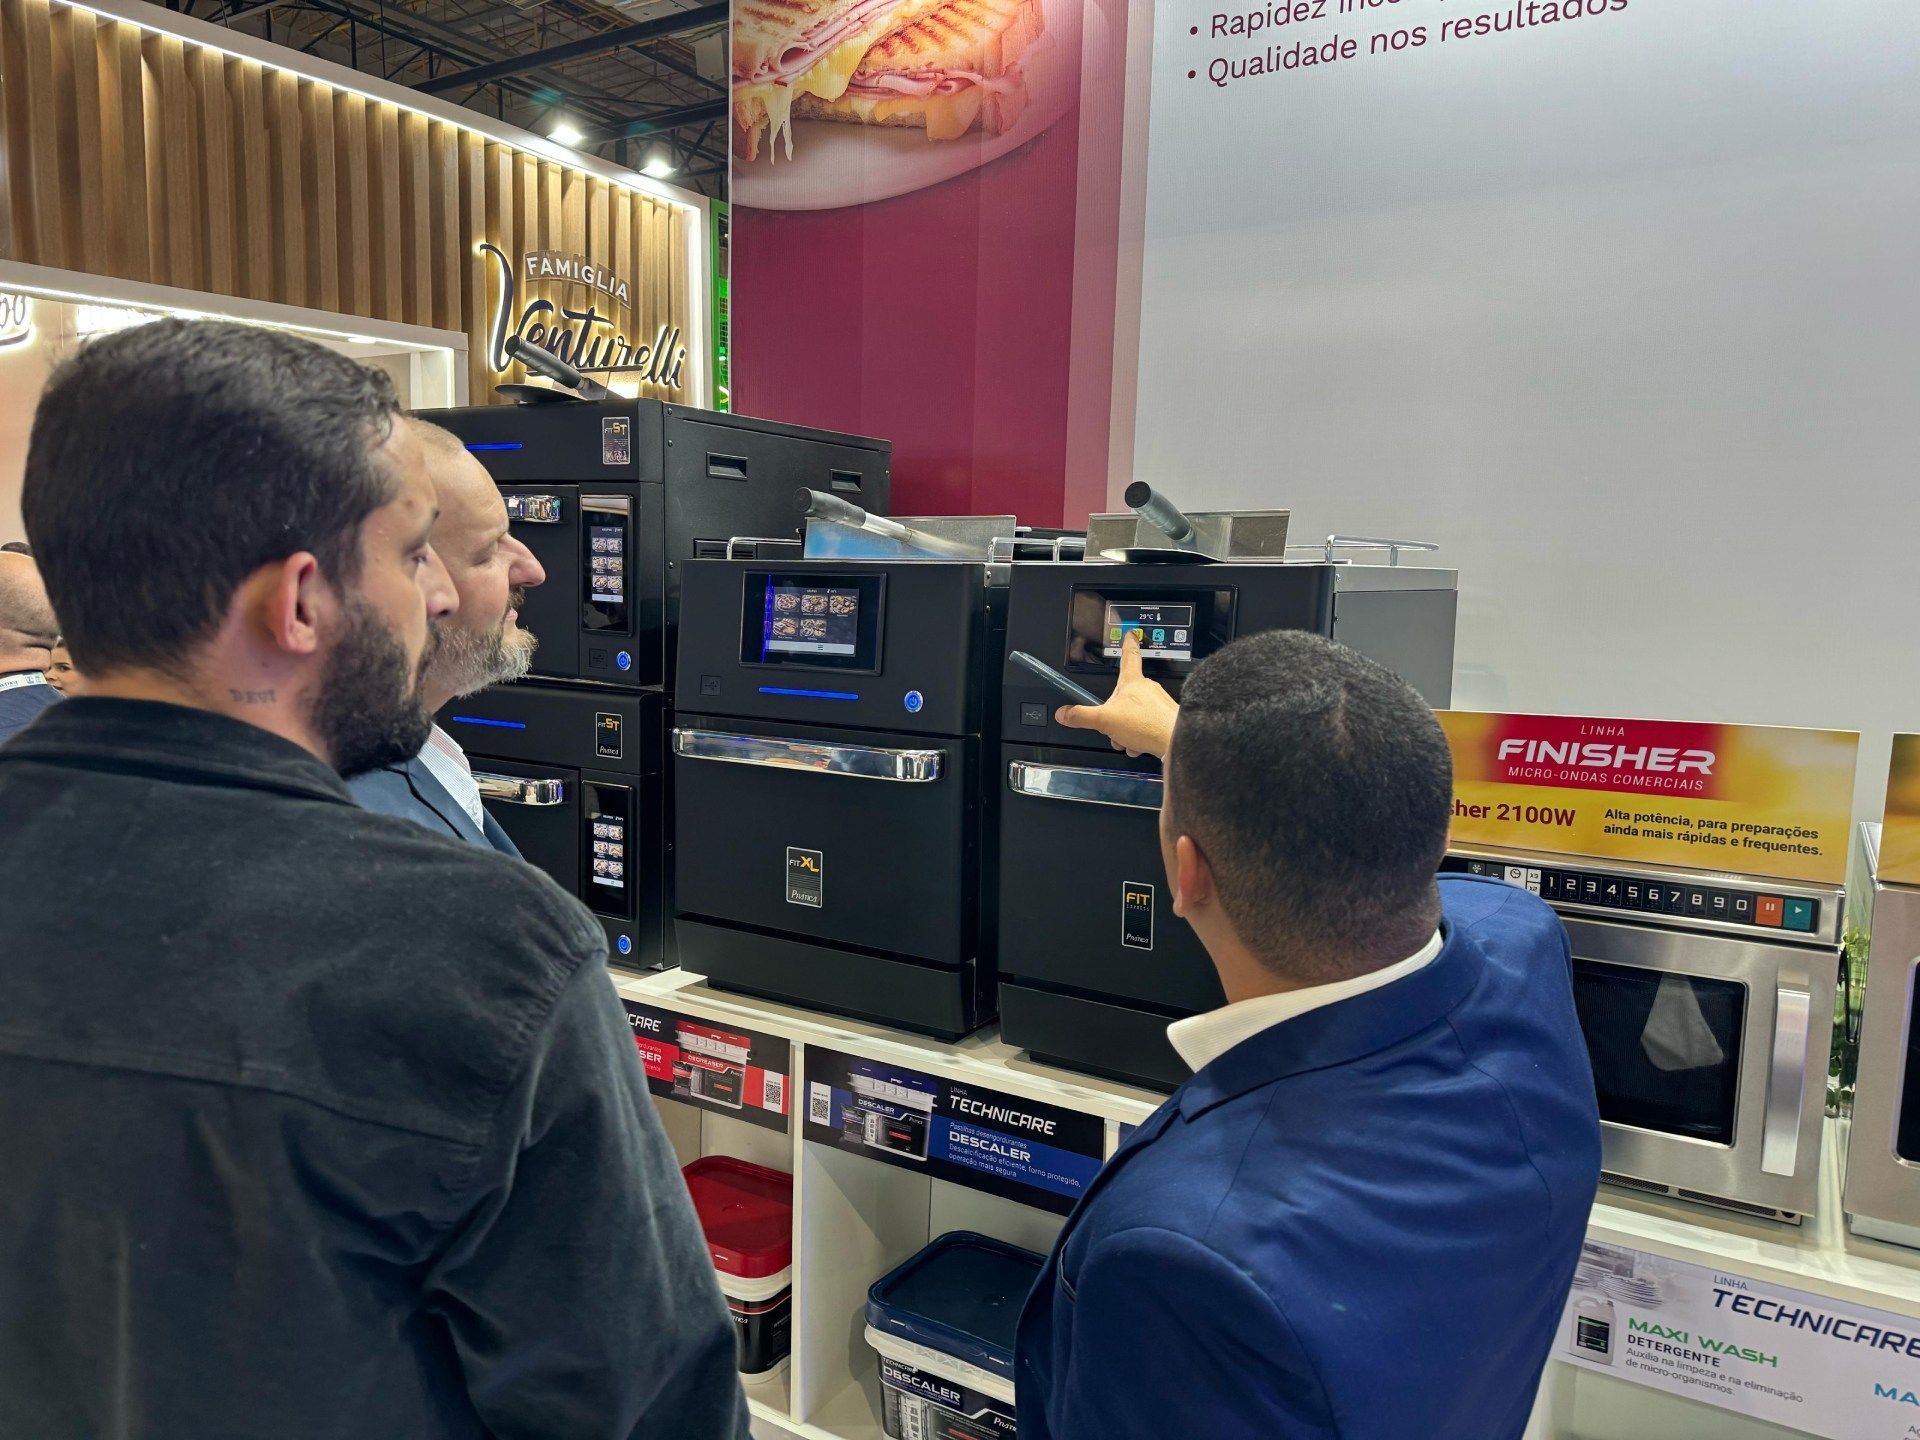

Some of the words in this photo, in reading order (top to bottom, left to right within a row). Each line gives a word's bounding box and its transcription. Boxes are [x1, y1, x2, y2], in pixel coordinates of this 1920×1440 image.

[1211, 0, 1327, 39] Rapidez
[1208, 34, 1358, 87] Qualidade
[1370, 26, 1427, 55] nos
[526, 256, 629, 302] FAMIGLIA
[479, 242, 688, 389] Venturelli
[1580, 724, 1626, 737] LINHA
[1497, 738, 1716, 774] FINISHER
[1508, 766, 1607, 784] MICRO-ONDAS
[1612, 773, 1704, 791] COMERCIAIS
[1496, 803, 1576, 827] 2100W
[1604, 808, 1630, 821] Alta
[1633, 812, 1694, 829] potência,
[1697, 818, 1728, 830] para
[1730, 822, 1819, 840] preparações
[1603, 823, 1639, 837] ainda
[1642, 828, 1674, 841] mais
[1676, 830, 1727, 846] rápidas
[1730, 837, 1739, 847] e
[1742, 836, 1824, 857] frequentes.
[1125, 892, 1151, 906] FIT
[1548, 876, 1554, 888] 1
[1566, 878, 1577, 890] 2
[1586, 881, 1597, 893] 3
[1606, 884, 1618, 895] 4
[1627, 886, 1639, 898] 5
[1648, 888, 1660, 901] 6
[1670, 891, 1681, 902] 7
[1691, 894, 1703, 905] 8
[1713, 896, 1725, 908] 9
[1736, 899, 1748, 911] 0
[857, 1098, 895, 1115] DESCALER
[950, 1086, 968, 1096] LINHA
[949, 1094, 1057, 1136] TECHNICARE
[949, 1130, 1031, 1163] DESCALER
[948, 1152, 978, 1167] operação
[978, 1161, 994, 1171] mais
[995, 1166, 1017, 1178] segura
[1028, 1165, 1046, 1178] forno
[1713, 1274, 1749, 1291] LINHA
[1712, 1287, 1920, 1359] TECHNICARE
[1627, 1333, 1721, 1368] DETERGENTE
[1628, 1317, 1689, 1344] MAXI
[1698, 1335, 1778, 1368] WASH
[882, 1365, 961, 1402] DESCALER
[1625, 1357, 1639, 1369] de
[1640, 1362, 1735, 1396] micro-organismos.
[1626, 1347, 1659, 1364] Auxilia
[1661, 1358, 1675, 1368] na
[1676, 1361, 1717, 1379] limpeza
[1719, 1373, 1726, 1382] e
[1728, 1375, 1742, 1387] na
[1744, 1378, 1804, 1403] eliminação
